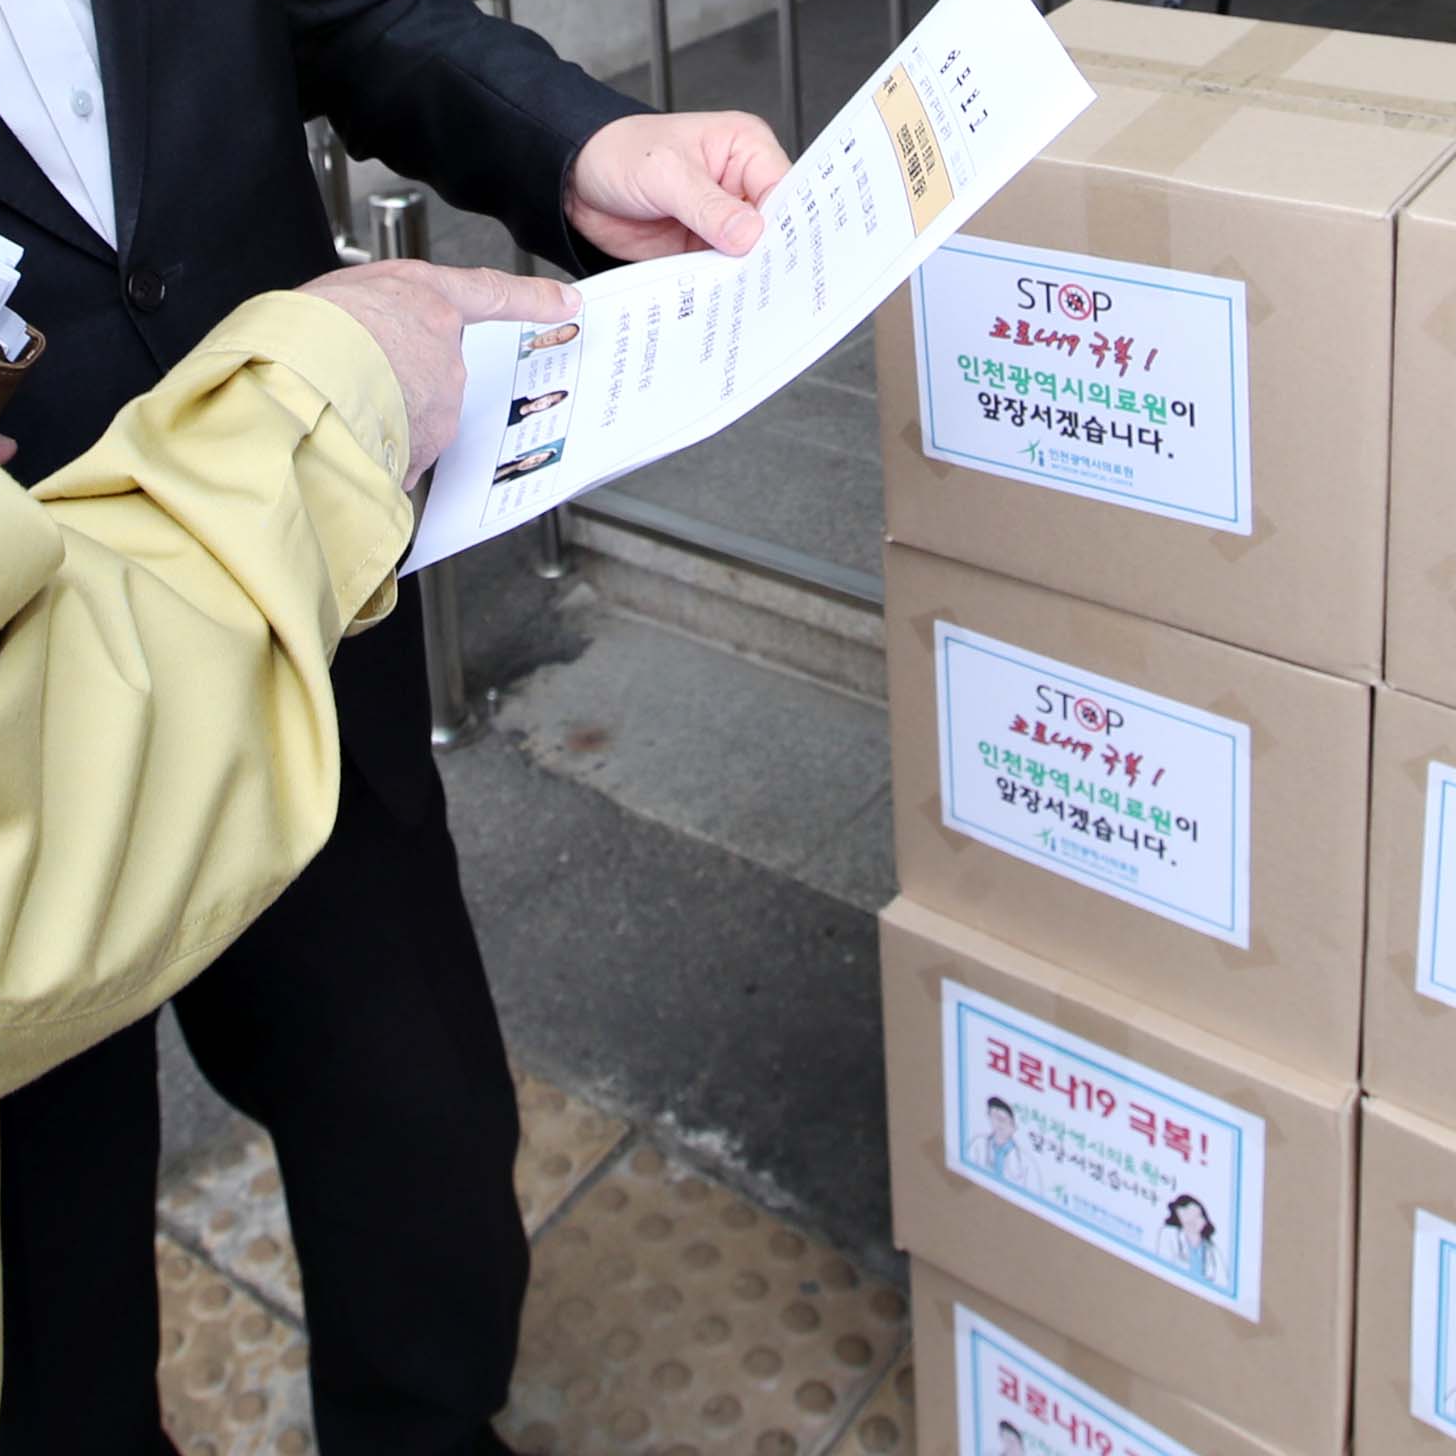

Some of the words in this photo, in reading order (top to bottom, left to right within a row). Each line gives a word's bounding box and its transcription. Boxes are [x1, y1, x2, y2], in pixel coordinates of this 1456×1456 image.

[1016, 277, 1113, 322] STOP
[957, 354, 1196, 427] 인천광역시의료원이
[978, 391, 1175, 459] 앞장서겠습니다.
[1035, 684, 1125, 736] STOP
[978, 740, 1199, 843] 인천광역시의료원이
[996, 775, 1178, 867] 앞장서겠습니다.
[986, 1036, 1117, 1119] 코로나19
[1128, 1101, 1210, 1167] 극복!
[997, 1364, 1114, 1456] 코로나19
